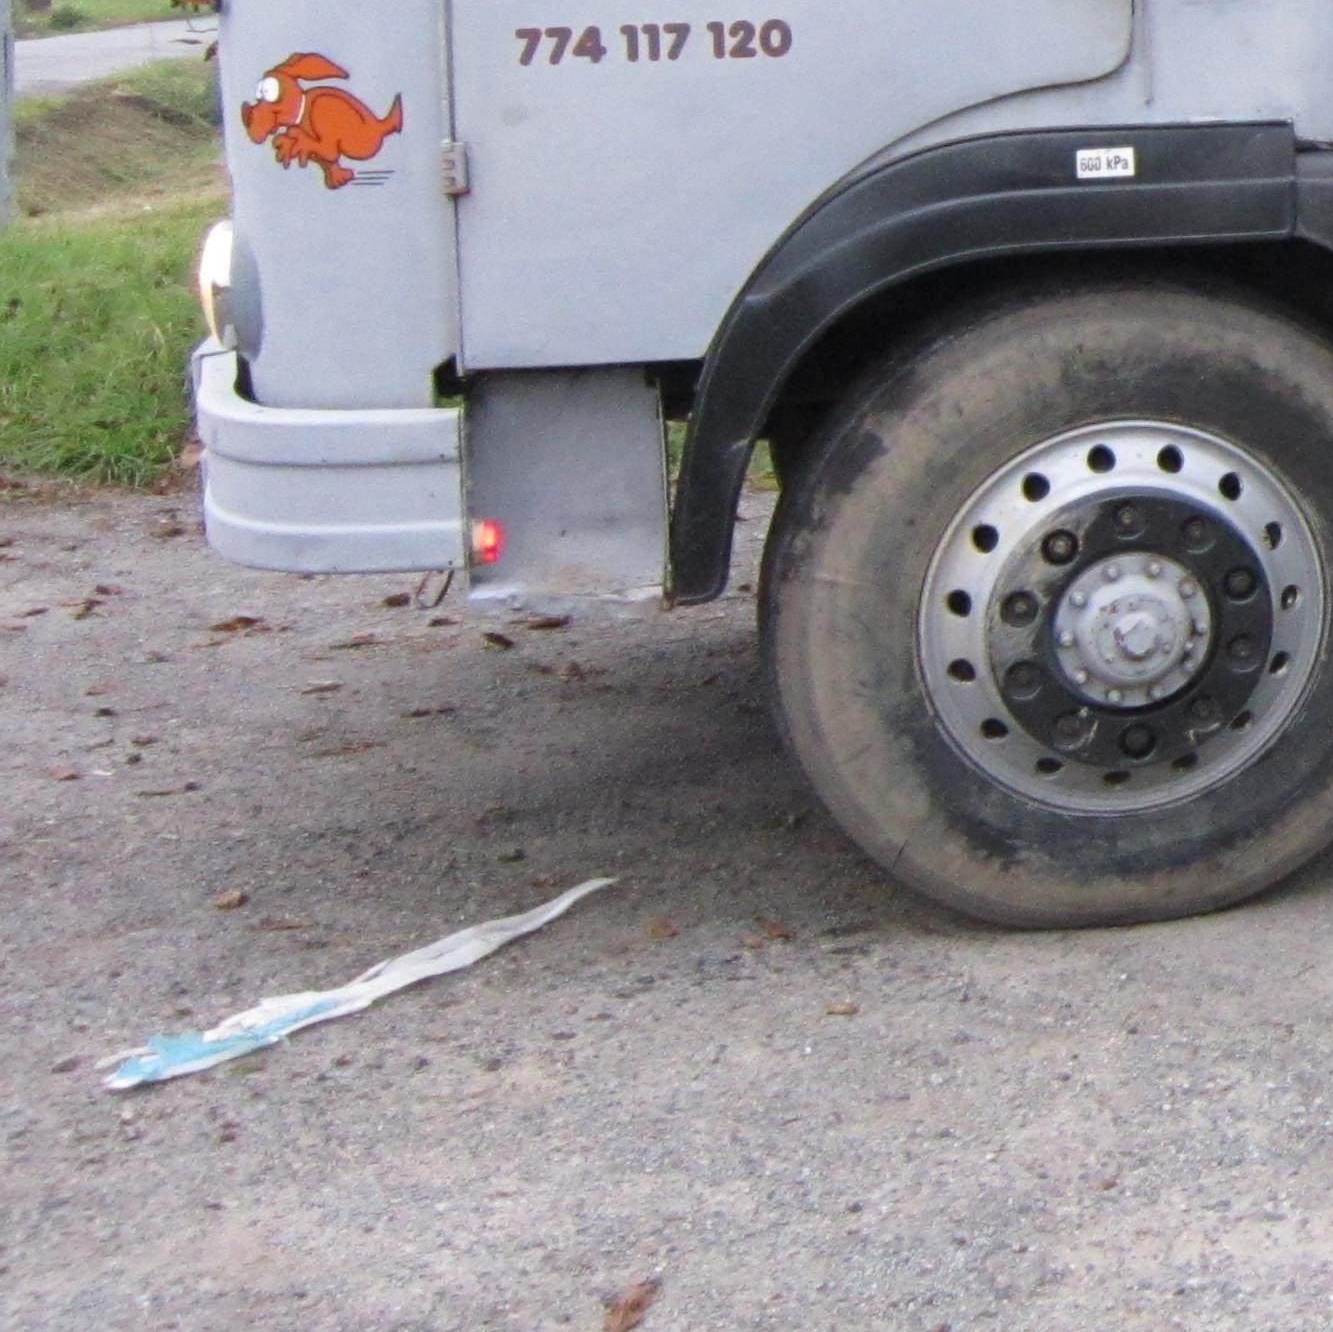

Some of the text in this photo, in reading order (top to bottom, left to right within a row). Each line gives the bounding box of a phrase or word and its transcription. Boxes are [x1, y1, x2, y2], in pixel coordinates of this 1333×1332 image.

[515, 19, 793, 66] 774 117 120
[1106, 155, 1129, 170] kPa
